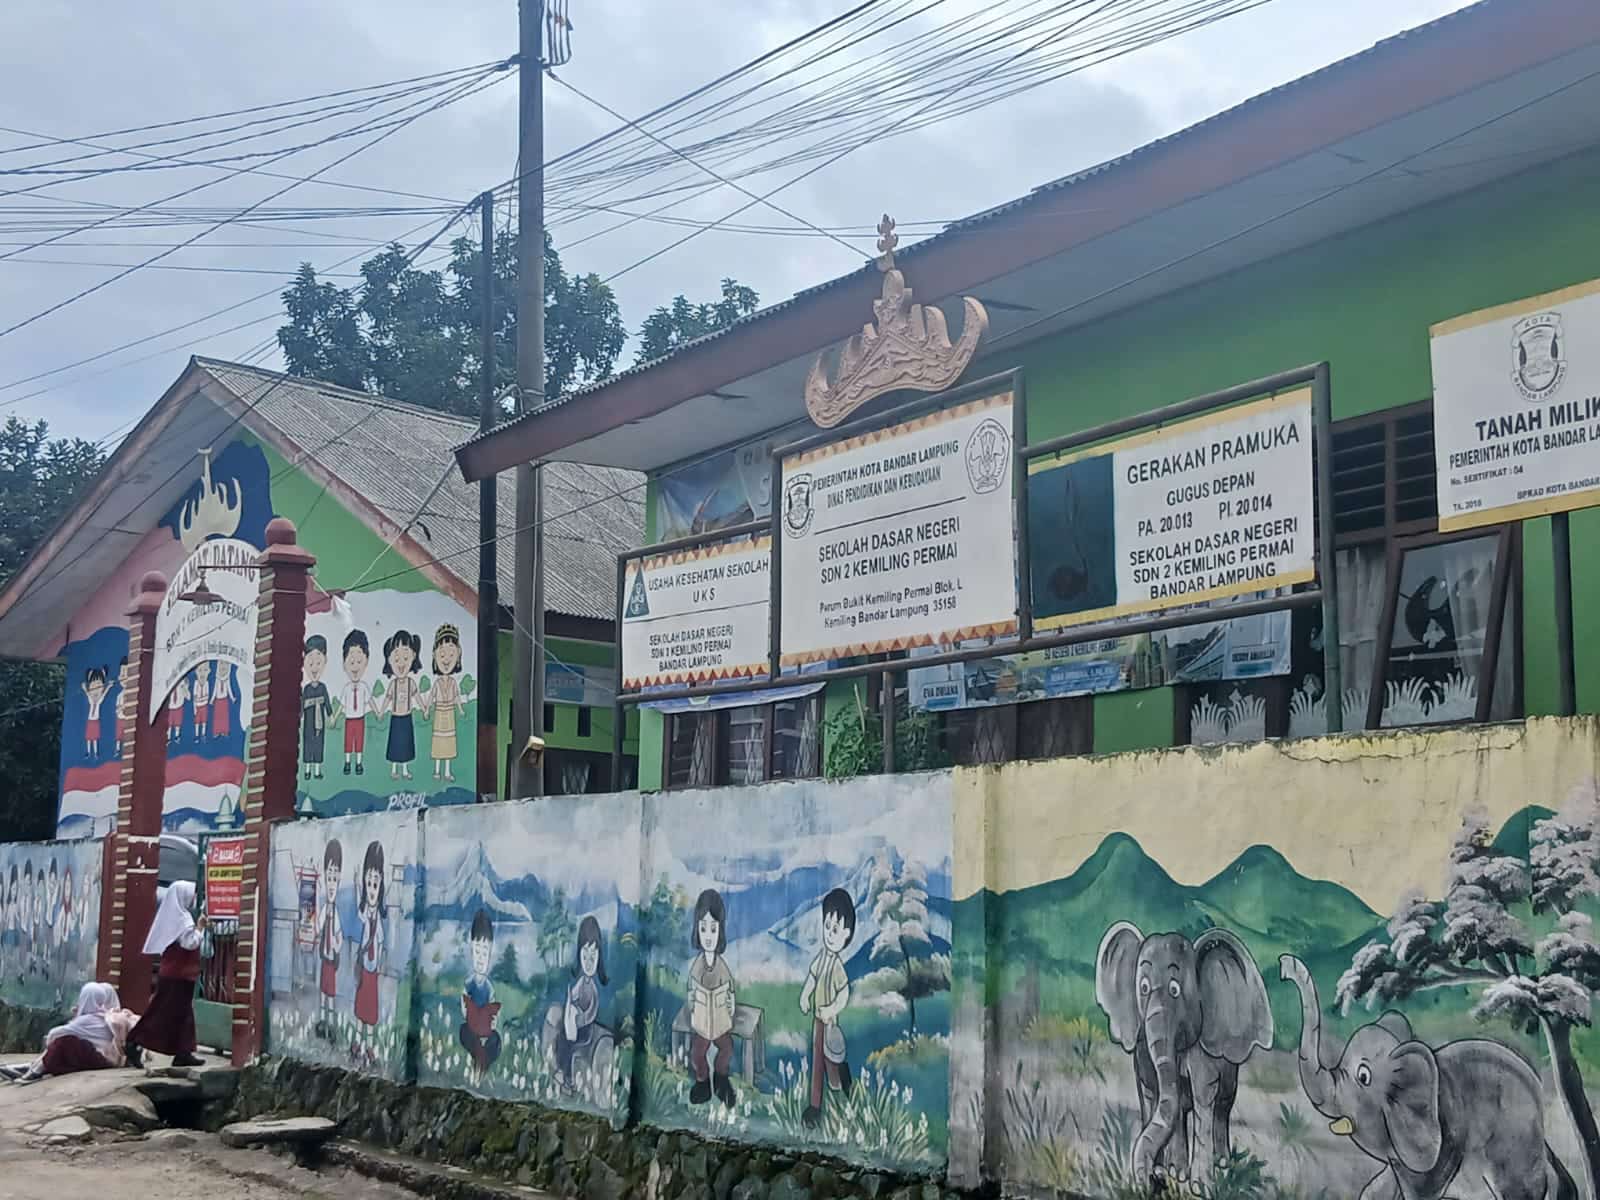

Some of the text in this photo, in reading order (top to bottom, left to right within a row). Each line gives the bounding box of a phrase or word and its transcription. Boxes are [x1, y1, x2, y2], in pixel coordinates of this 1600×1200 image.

[1475, 409, 1542, 442] TANAH
[813, 467, 858, 492] PEMERINTAH
[860, 462, 882, 478] KOTA
[884, 453, 917, 472] BANDAR
[919, 440, 959, 463] LAMPUNG
[1127, 423, 1300, 485] GERAKAN PRAMUKA
[1450, 444, 1510, 469] PEMERINTAH
[1513, 437, 1541, 457] KOTA
[1543, 428, 1586, 451] BANDAR
[827, 466, 942, 509] DINAS PENDIDIKAN DAN KEBUDAYAAN
[1167, 471, 1256, 507] GUGUS DEPAN
[1464, 468, 1508, 484] SERTIFIKAT
[1546, 484, 1567, 495] KOTA
[1138, 494, 1273, 537] PA. 20.013 PI. 20.014
[819, 516, 960, 562] SEKOLAH DASAR NEGERI
[1129, 517, 1298, 566] SEKOLAH DASAR NEGERI
[213, 543, 257, 583] DATANG
[648, 558, 769, 591] USAHA KESEHATAN SEKOLAH
[821, 541, 958, 584] SDN 2 KEMILING PERMAI
[1133, 538, 1294, 584] SDN 2 KEMILING PERMAI
[866, 590, 902, 604] Kemiling
[904, 584, 933, 600] Permai
[957, 578, 963, 590] L
[1150, 562, 1276, 600] BANDAR LAMPUNG
[824, 614, 857, 628] Kemiling
[858, 608, 889, 624] Bandar
[890, 603, 929, 619] Lampung
[649, 624, 734, 646] SEKOLAH DASAR NEGERI
[651, 647, 665, 659] SDN
[671, 642, 703, 657] KEMILING
[659, 654, 723, 672] BANDAR LAMPUNG
[387, 792, 429, 812] PROFIL
